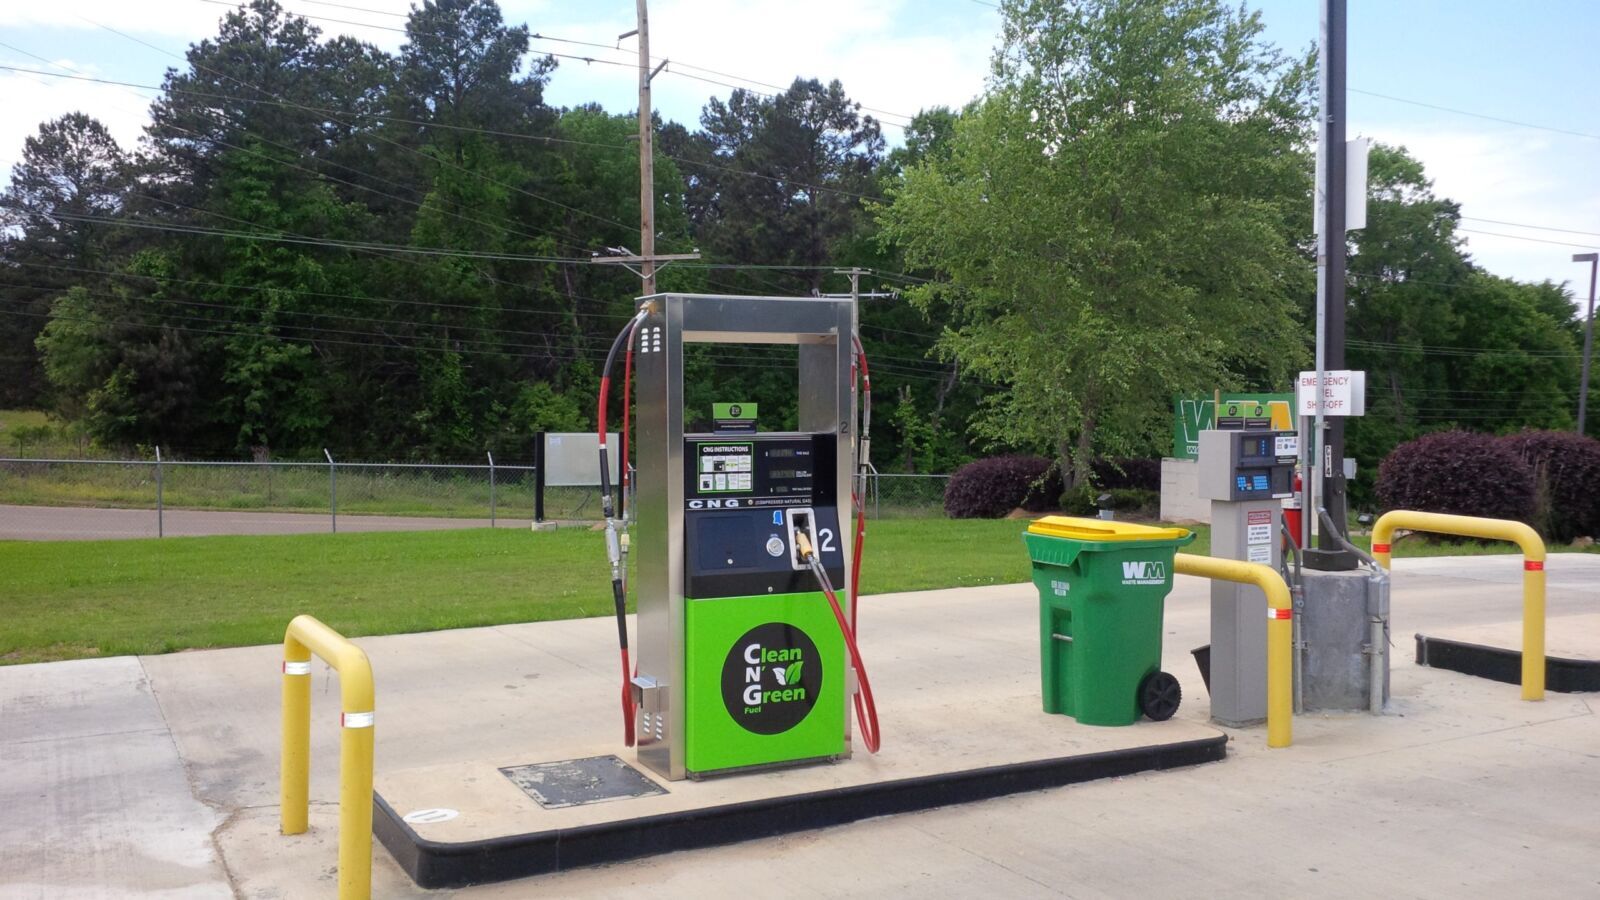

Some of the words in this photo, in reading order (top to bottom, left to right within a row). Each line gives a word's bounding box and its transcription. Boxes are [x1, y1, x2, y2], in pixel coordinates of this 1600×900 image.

[1302, 377, 1349, 386] EMEGENCY
[1307, 400, 1343, 409] SHT-OFF
[841, 422, 848, 434] 2
[689, 500, 739, 509] CNG
[819, 528, 836, 552] 2
[1122, 561, 1165, 579] WM
[744, 643, 802, 665] Clean
[743, 684, 806, 706] Green
[744, 706, 761, 714] Fuel
